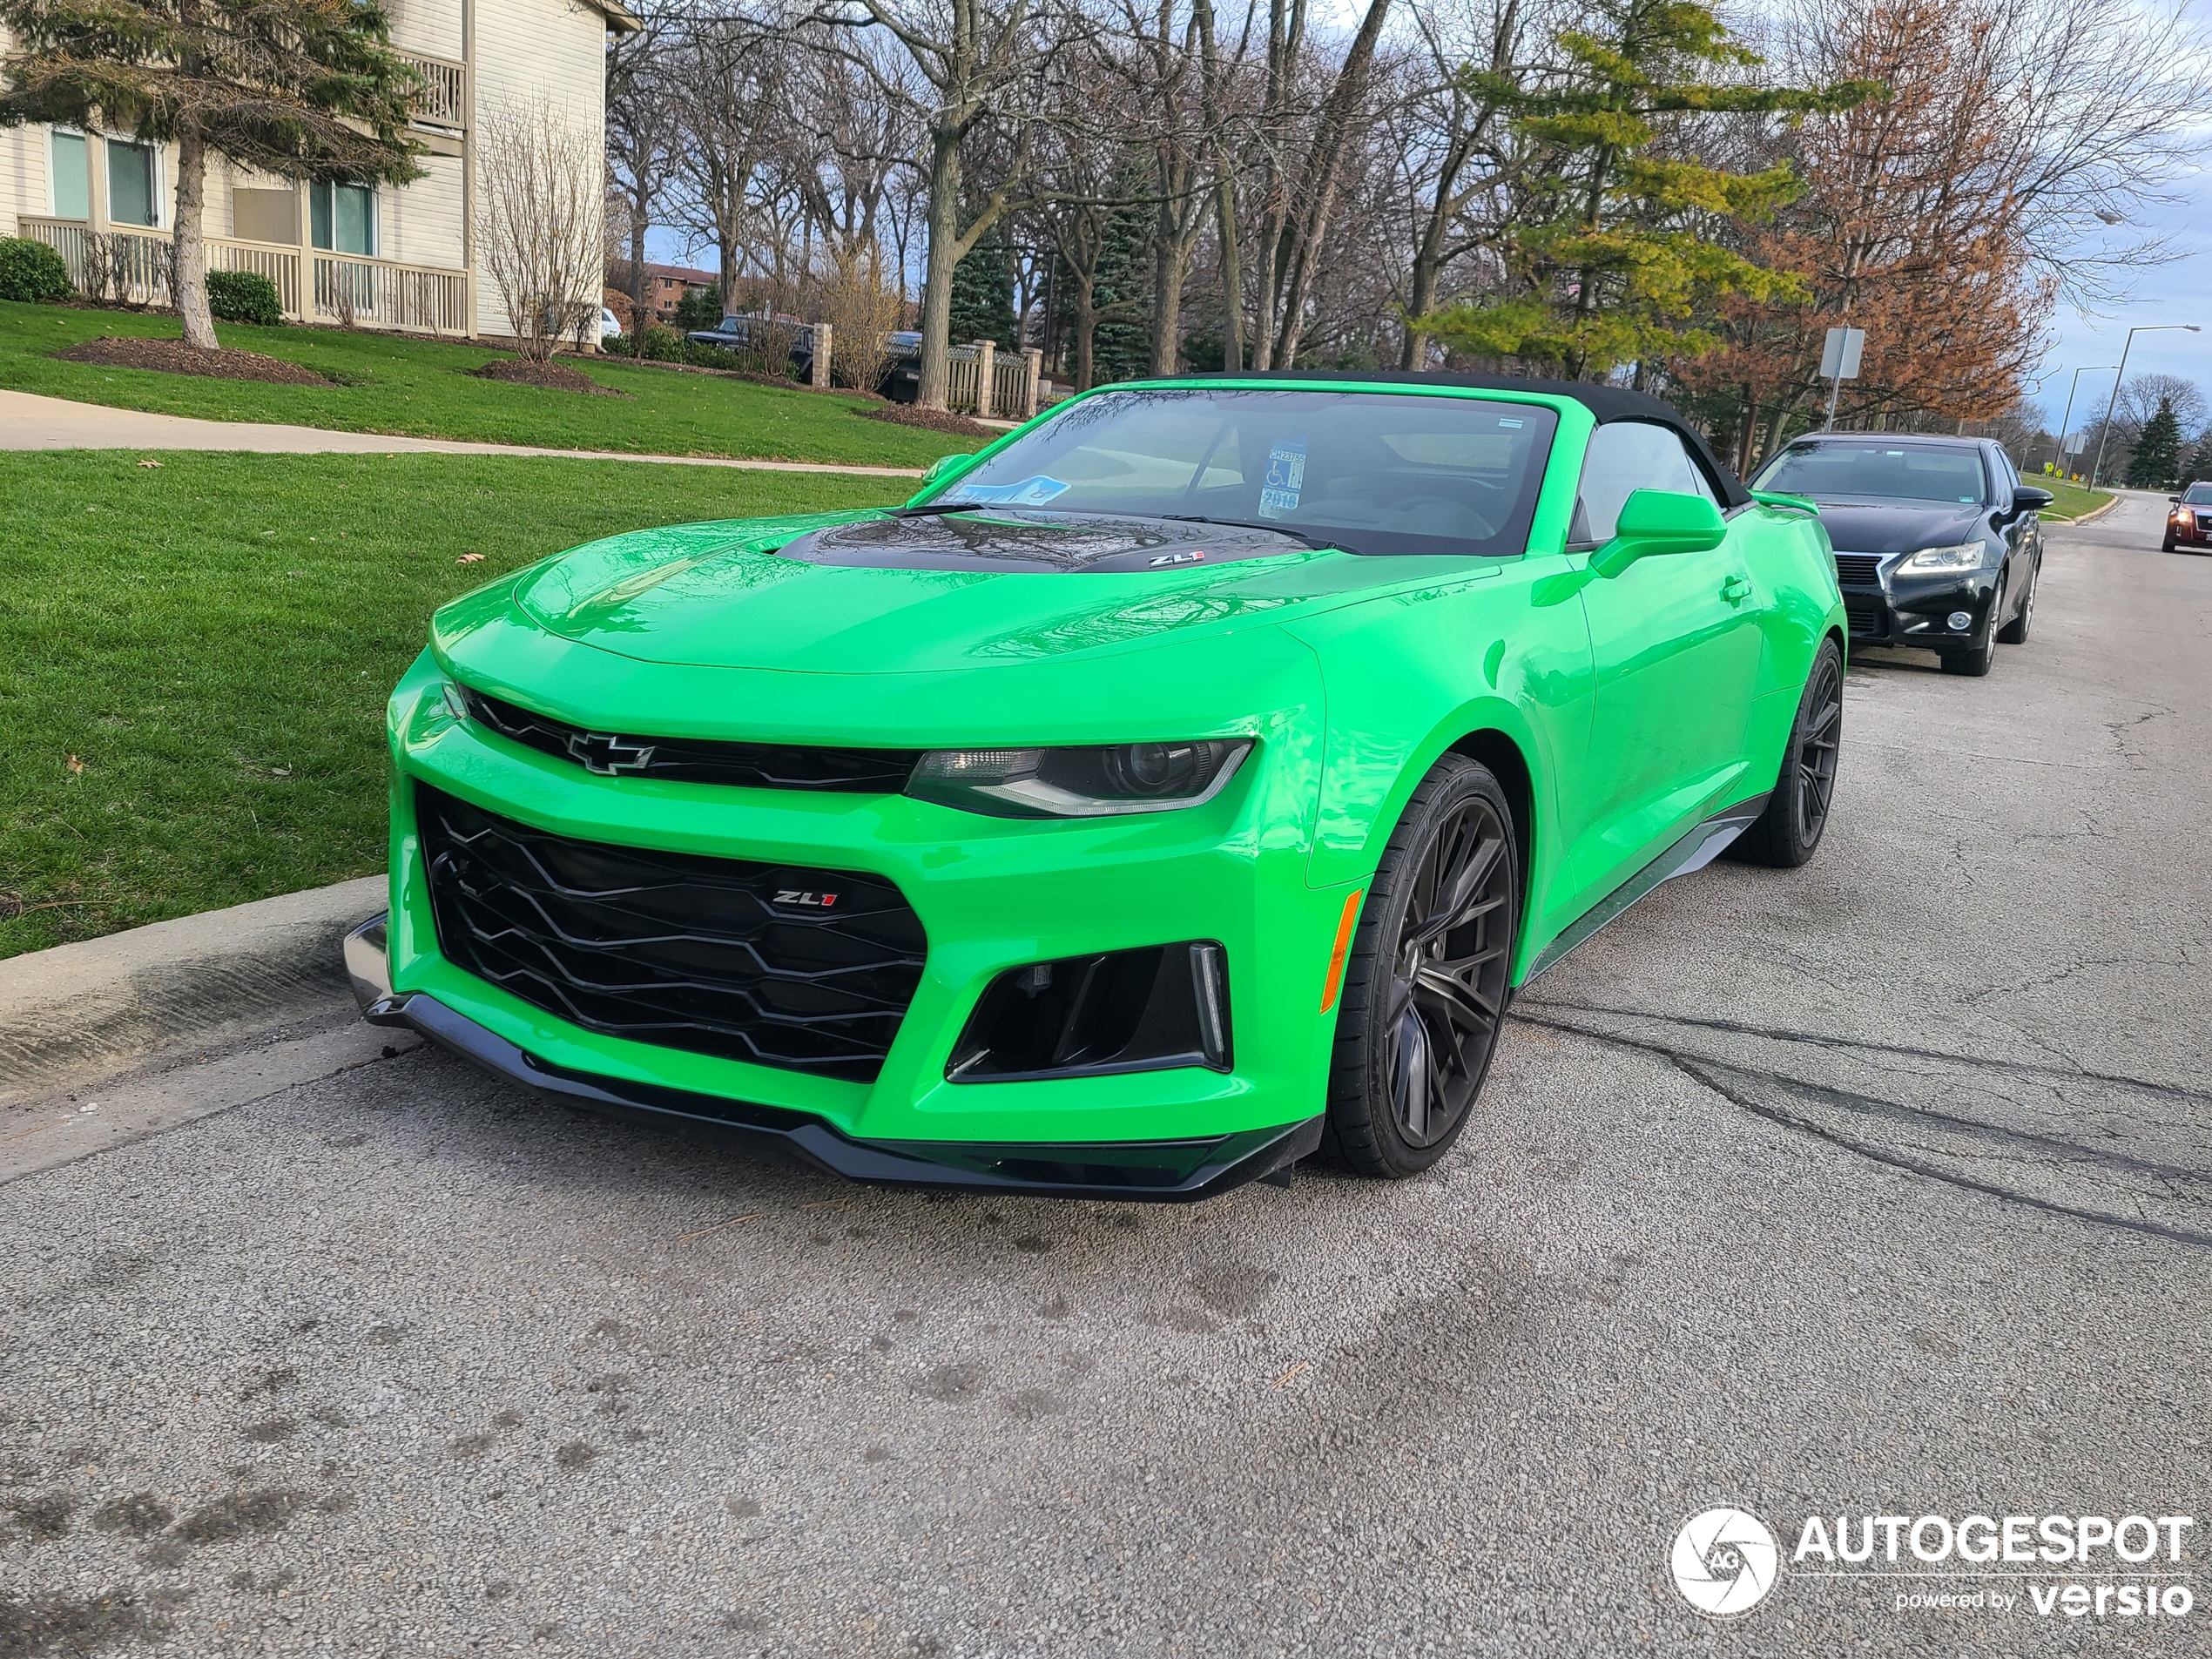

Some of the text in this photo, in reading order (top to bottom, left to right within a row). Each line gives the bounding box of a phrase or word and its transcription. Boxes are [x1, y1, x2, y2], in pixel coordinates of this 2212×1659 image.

[1271, 449, 1305, 462] CH23755
[1149, 550, 1206, 567] ZL1
[772, 889, 839, 907] ZL1
